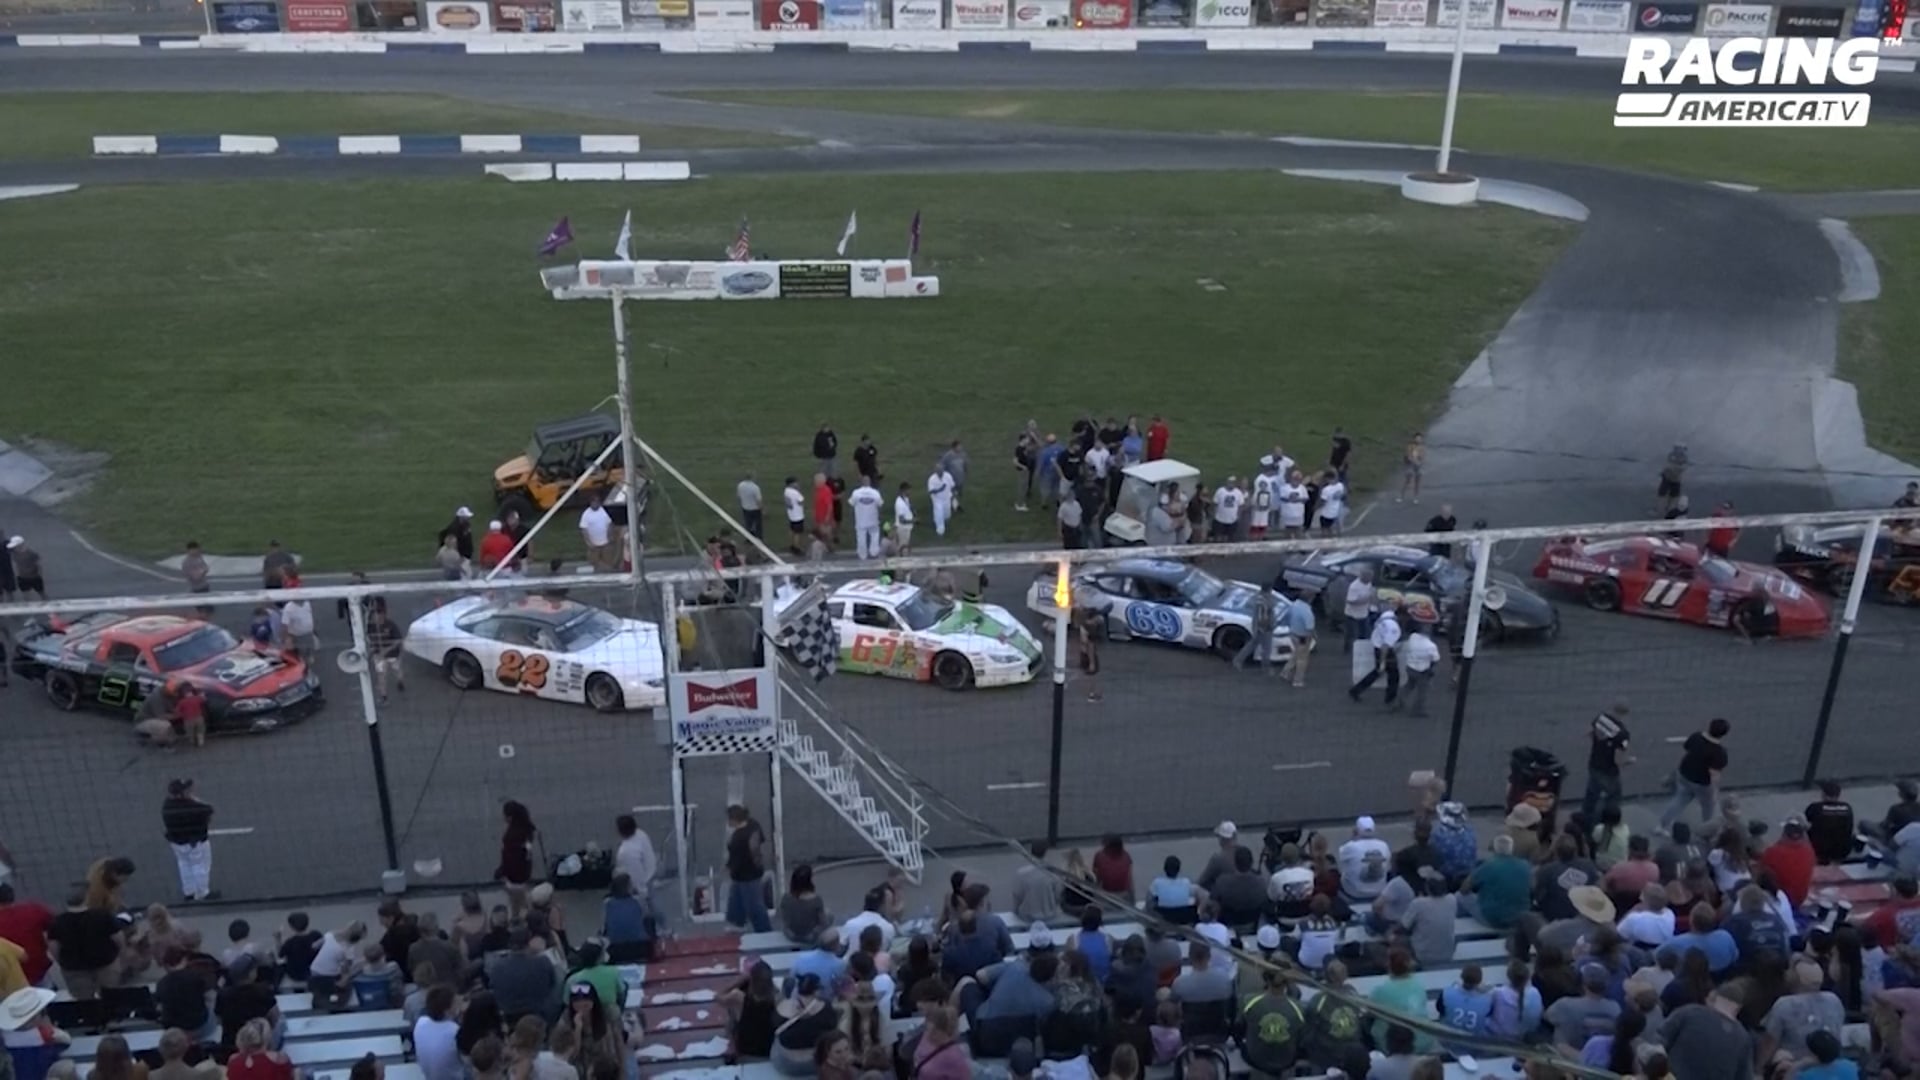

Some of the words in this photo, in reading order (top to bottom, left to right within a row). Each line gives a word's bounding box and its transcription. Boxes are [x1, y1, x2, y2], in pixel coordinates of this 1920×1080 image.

[1218, 6, 1249, 16] ICCU
[1642, 578, 1690, 608] 11
[1125, 600, 1183, 641] 69
[851, 633, 898, 668] 63
[496, 649, 550, 690] 22
[693, 692, 753, 704] Budweiser
[677, 718, 719, 738] Magic
[724, 717, 772, 731] Valley
[1452, 1007, 1478, 1029] 23
